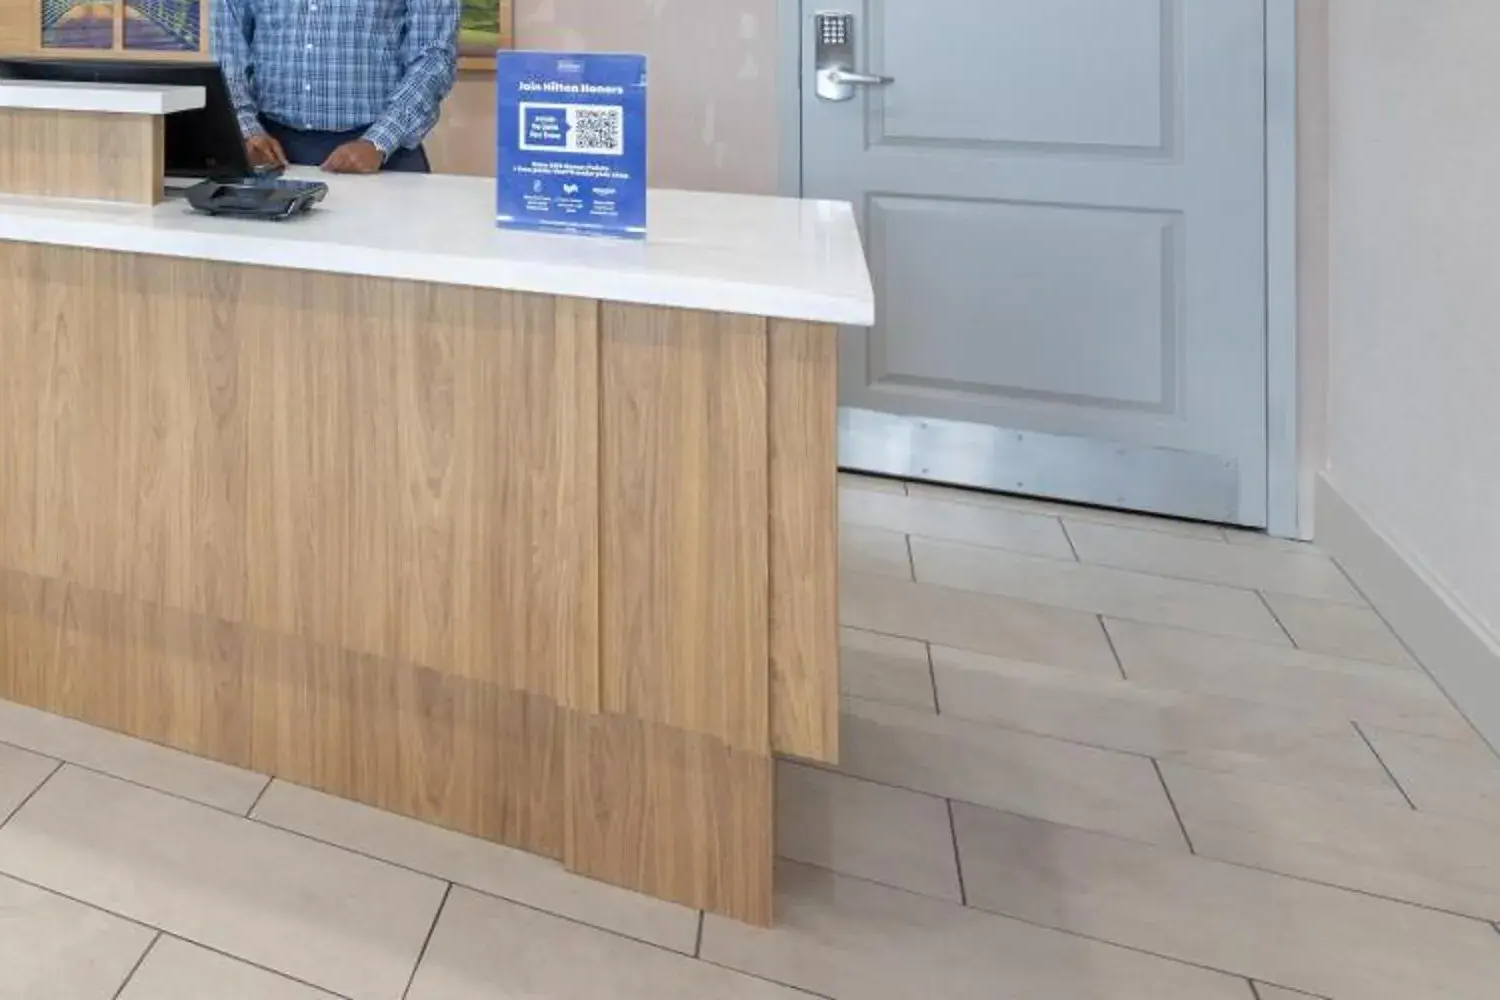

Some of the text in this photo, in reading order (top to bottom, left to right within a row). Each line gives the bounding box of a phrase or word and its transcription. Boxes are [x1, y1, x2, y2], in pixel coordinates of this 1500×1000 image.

[519, 81, 624, 95] Join Hilton Honors
